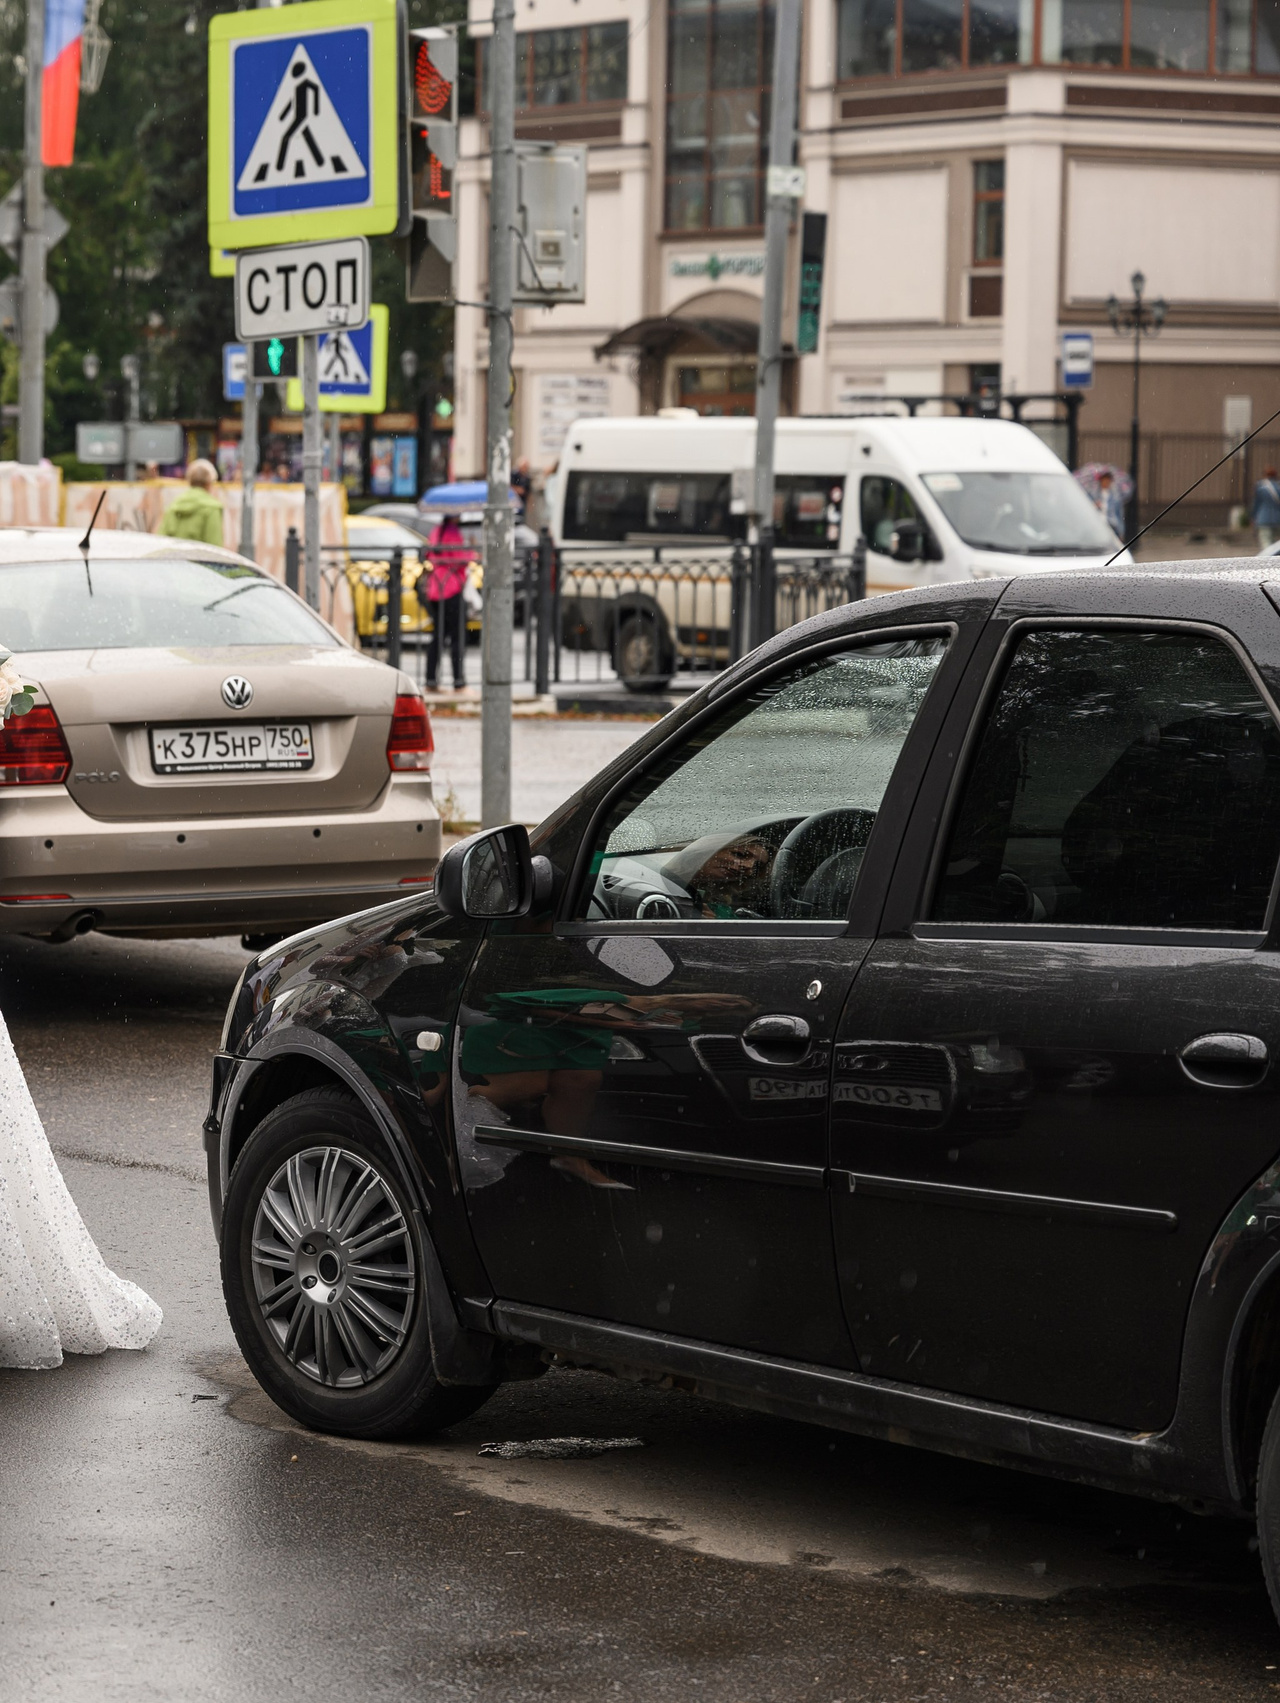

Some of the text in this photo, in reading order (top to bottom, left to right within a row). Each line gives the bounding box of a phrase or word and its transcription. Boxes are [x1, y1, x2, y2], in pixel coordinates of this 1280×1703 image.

[247, 258, 357, 315] СТОП
[266, 727, 303, 749] 750
[277, 749, 296, 757] RUS
[74, 771, 121, 784] POLO
